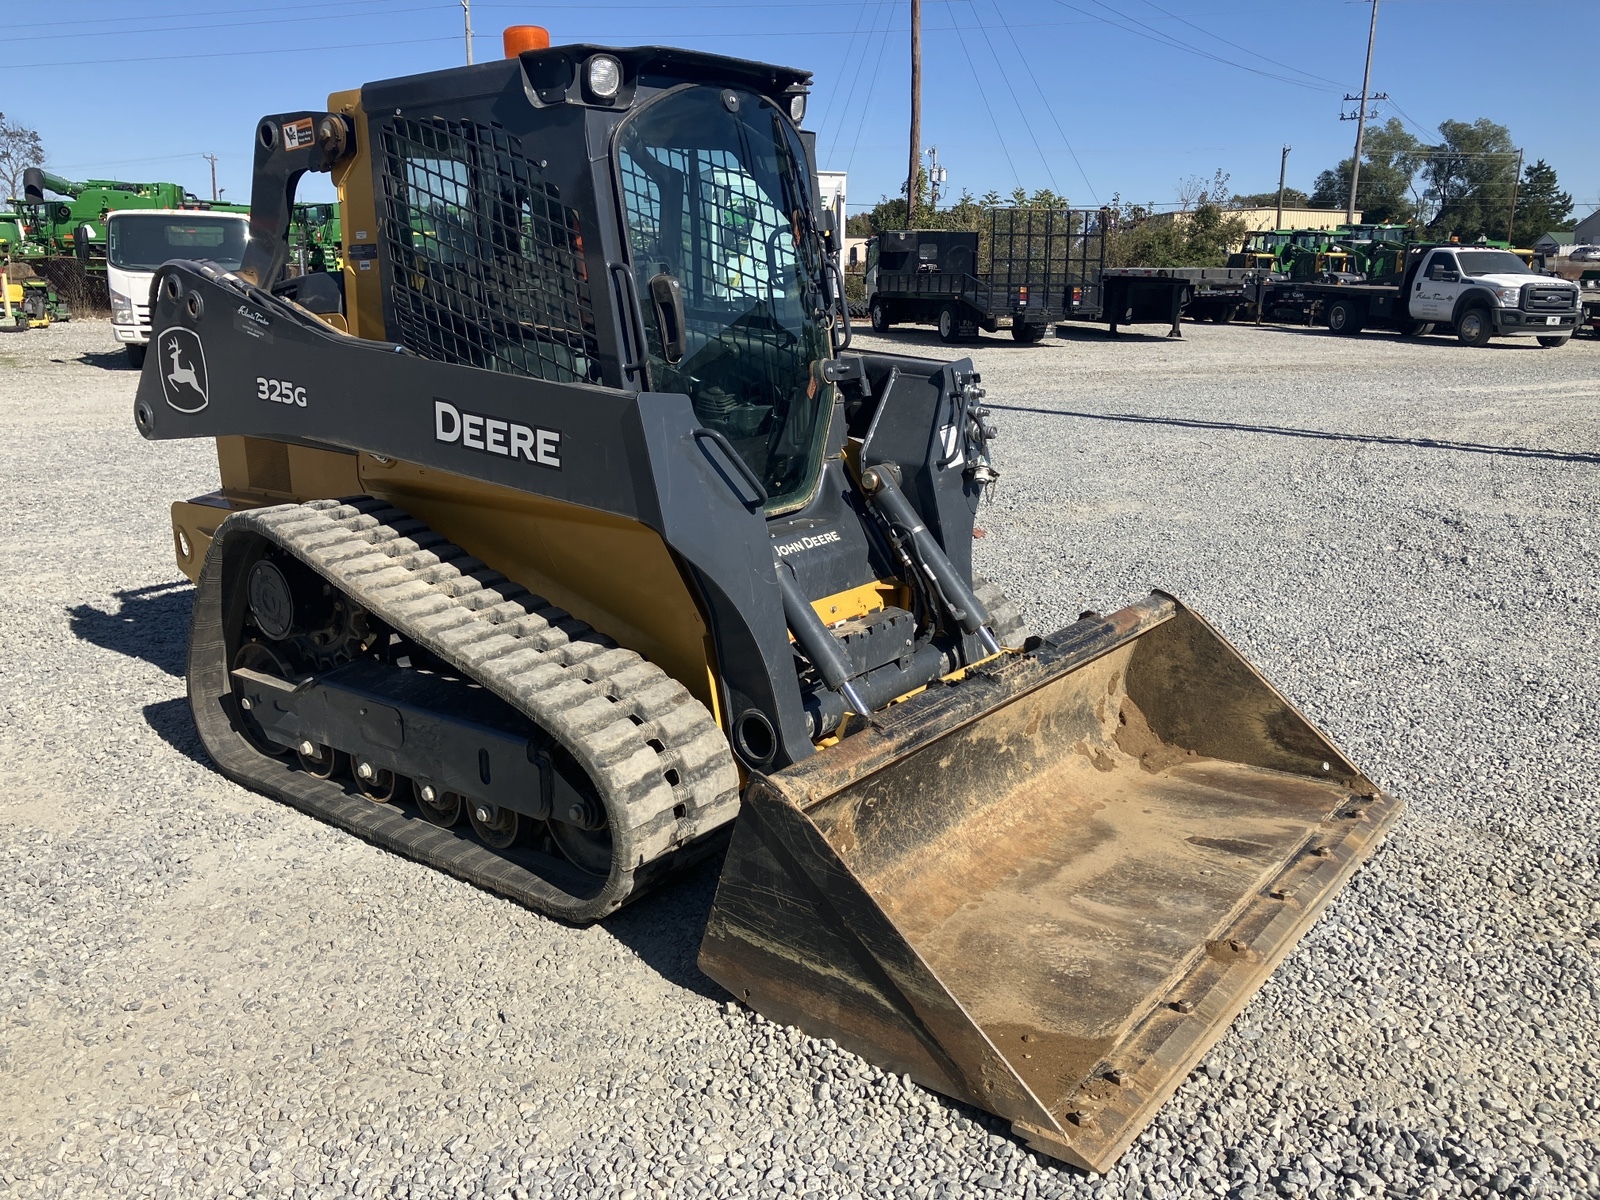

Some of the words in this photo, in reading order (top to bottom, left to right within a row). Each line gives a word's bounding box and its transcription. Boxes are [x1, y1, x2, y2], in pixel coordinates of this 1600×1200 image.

[256, 377, 308, 408] 325G
[434, 400, 561, 468] DEERE
[773, 541, 805, 557] JOHN
[801, 530, 841, 549] DEERE
